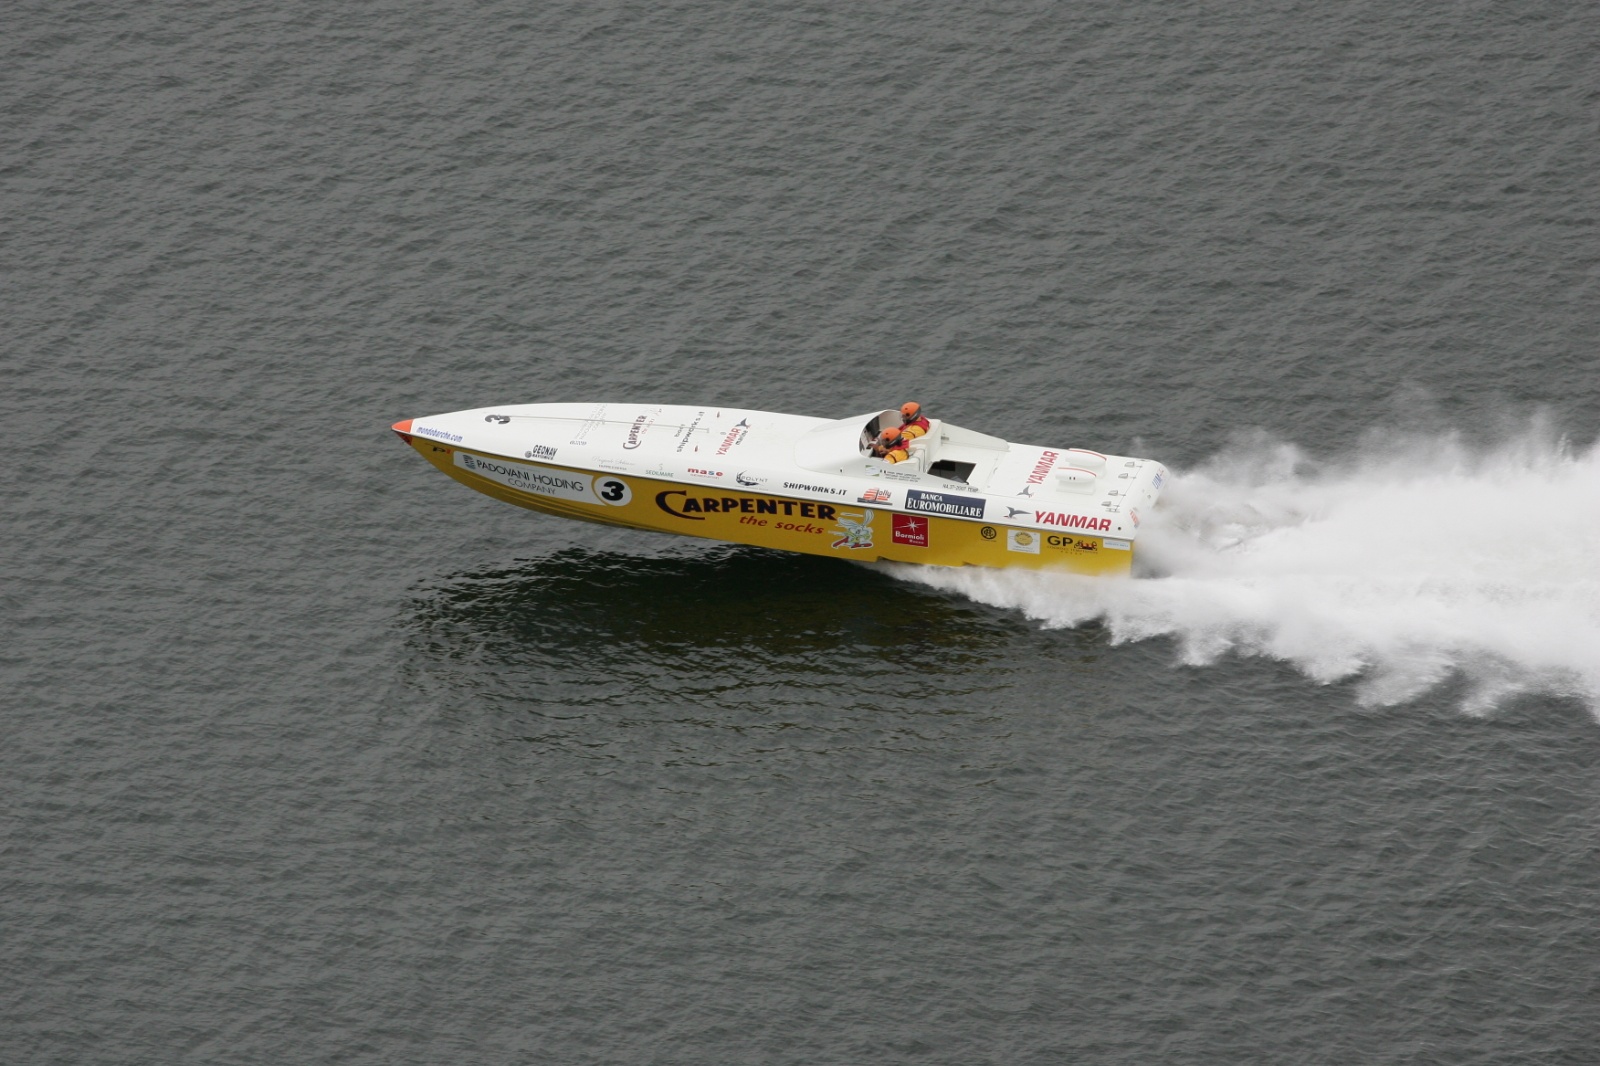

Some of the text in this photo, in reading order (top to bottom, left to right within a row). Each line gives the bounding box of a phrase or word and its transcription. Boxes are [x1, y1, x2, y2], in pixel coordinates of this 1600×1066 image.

[485, 414, 511, 425] 3
[715, 427, 741, 456] YANMAR
[477, 459, 584, 492] PADOVANI HOLDING
[687, 467, 724, 477] mase
[1026, 450, 1060, 485] YANMAR
[507, 478, 556, 495] COMPANY
[601, 481, 625, 502] 3
[782, 481, 848, 496] SHIPWORKS.IT
[655, 490, 838, 522] CARPENTER
[920, 492, 943, 502] BANCA
[907, 497, 982, 518] EUROMOBILIARE
[739, 515, 825, 535] the socks
[1035, 510, 1112, 532] YANMAR
[1047, 535, 1074, 547] GP
